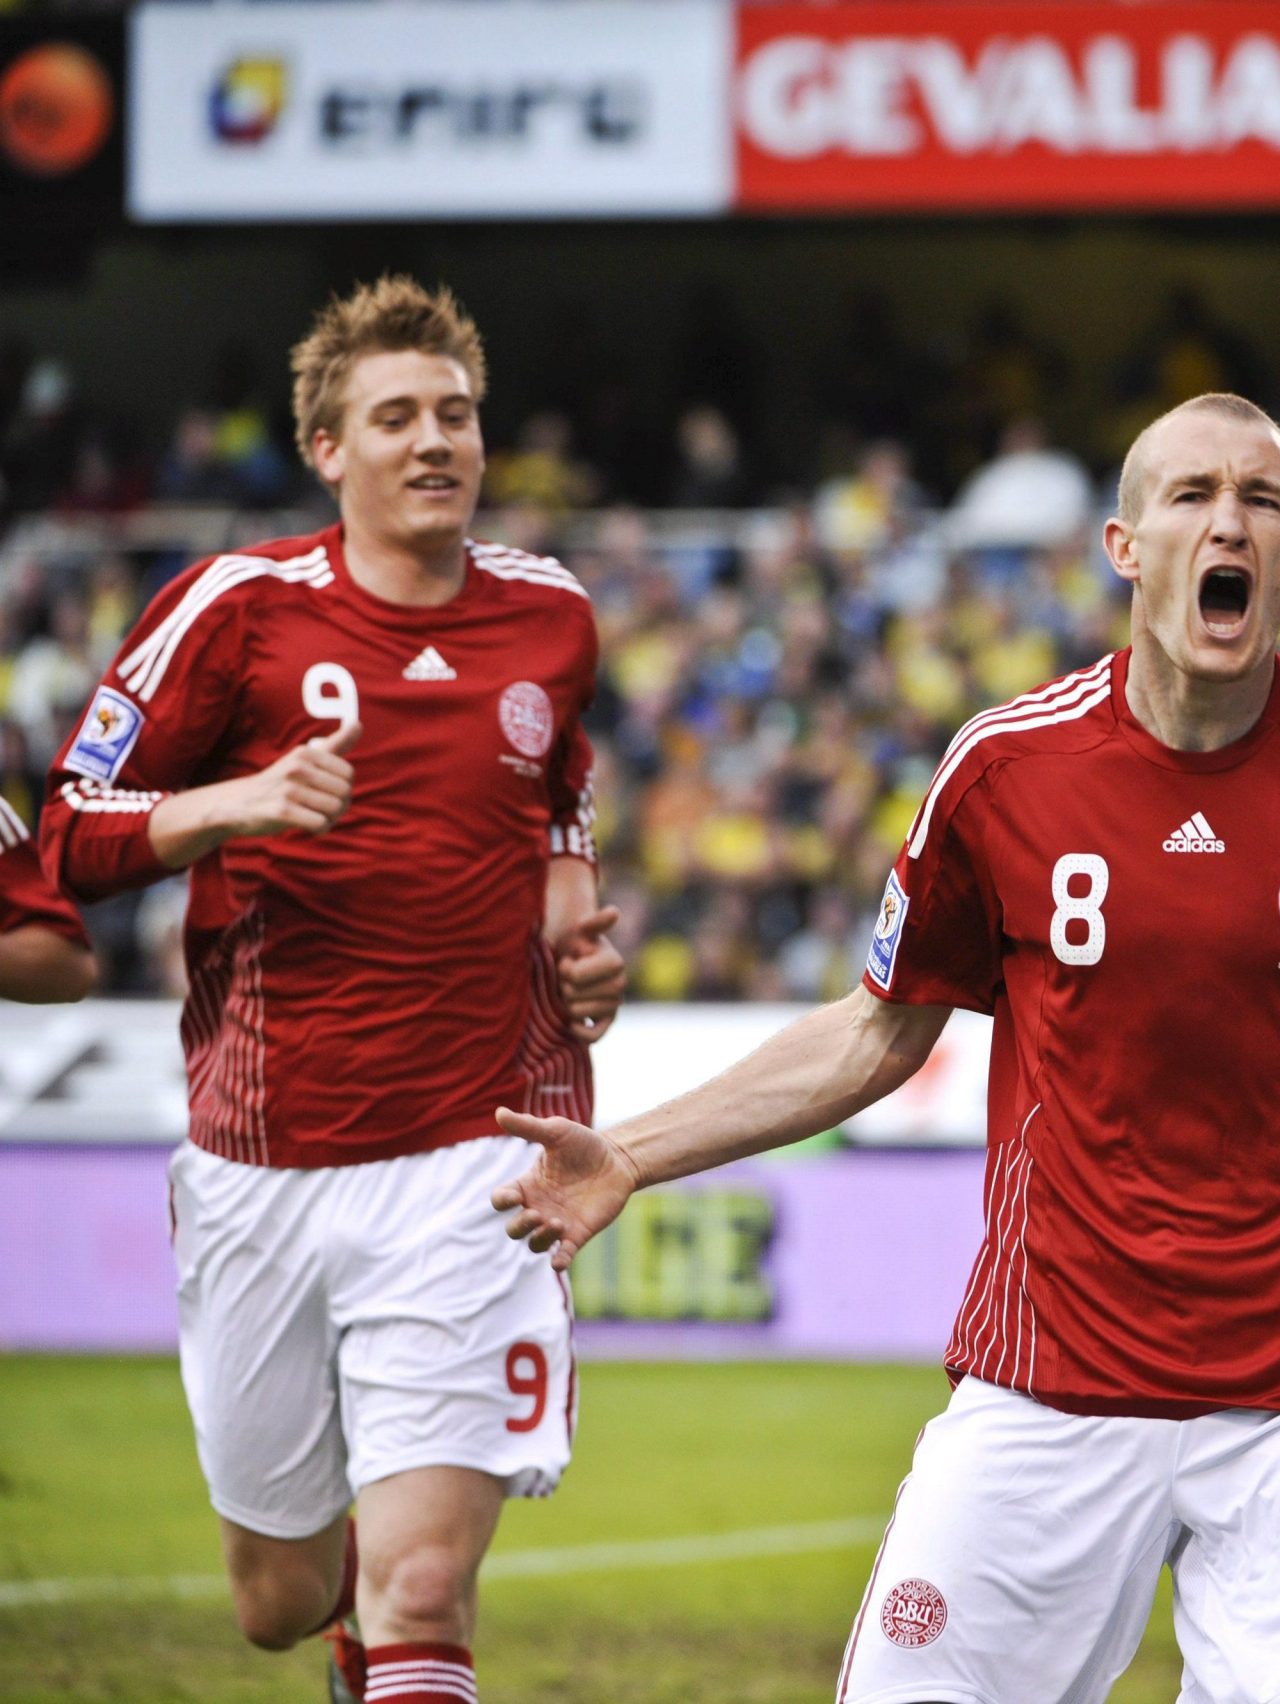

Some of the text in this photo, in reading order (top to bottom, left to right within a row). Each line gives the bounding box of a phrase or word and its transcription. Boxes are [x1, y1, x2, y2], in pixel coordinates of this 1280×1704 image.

[302, 662, 359, 742] 9
[1162, 837, 1226, 854] adidas
[1051, 853, 1109, 965] 8
[505, 1341, 548, 1433] 9
[893, 1599, 932, 1625] DBU
